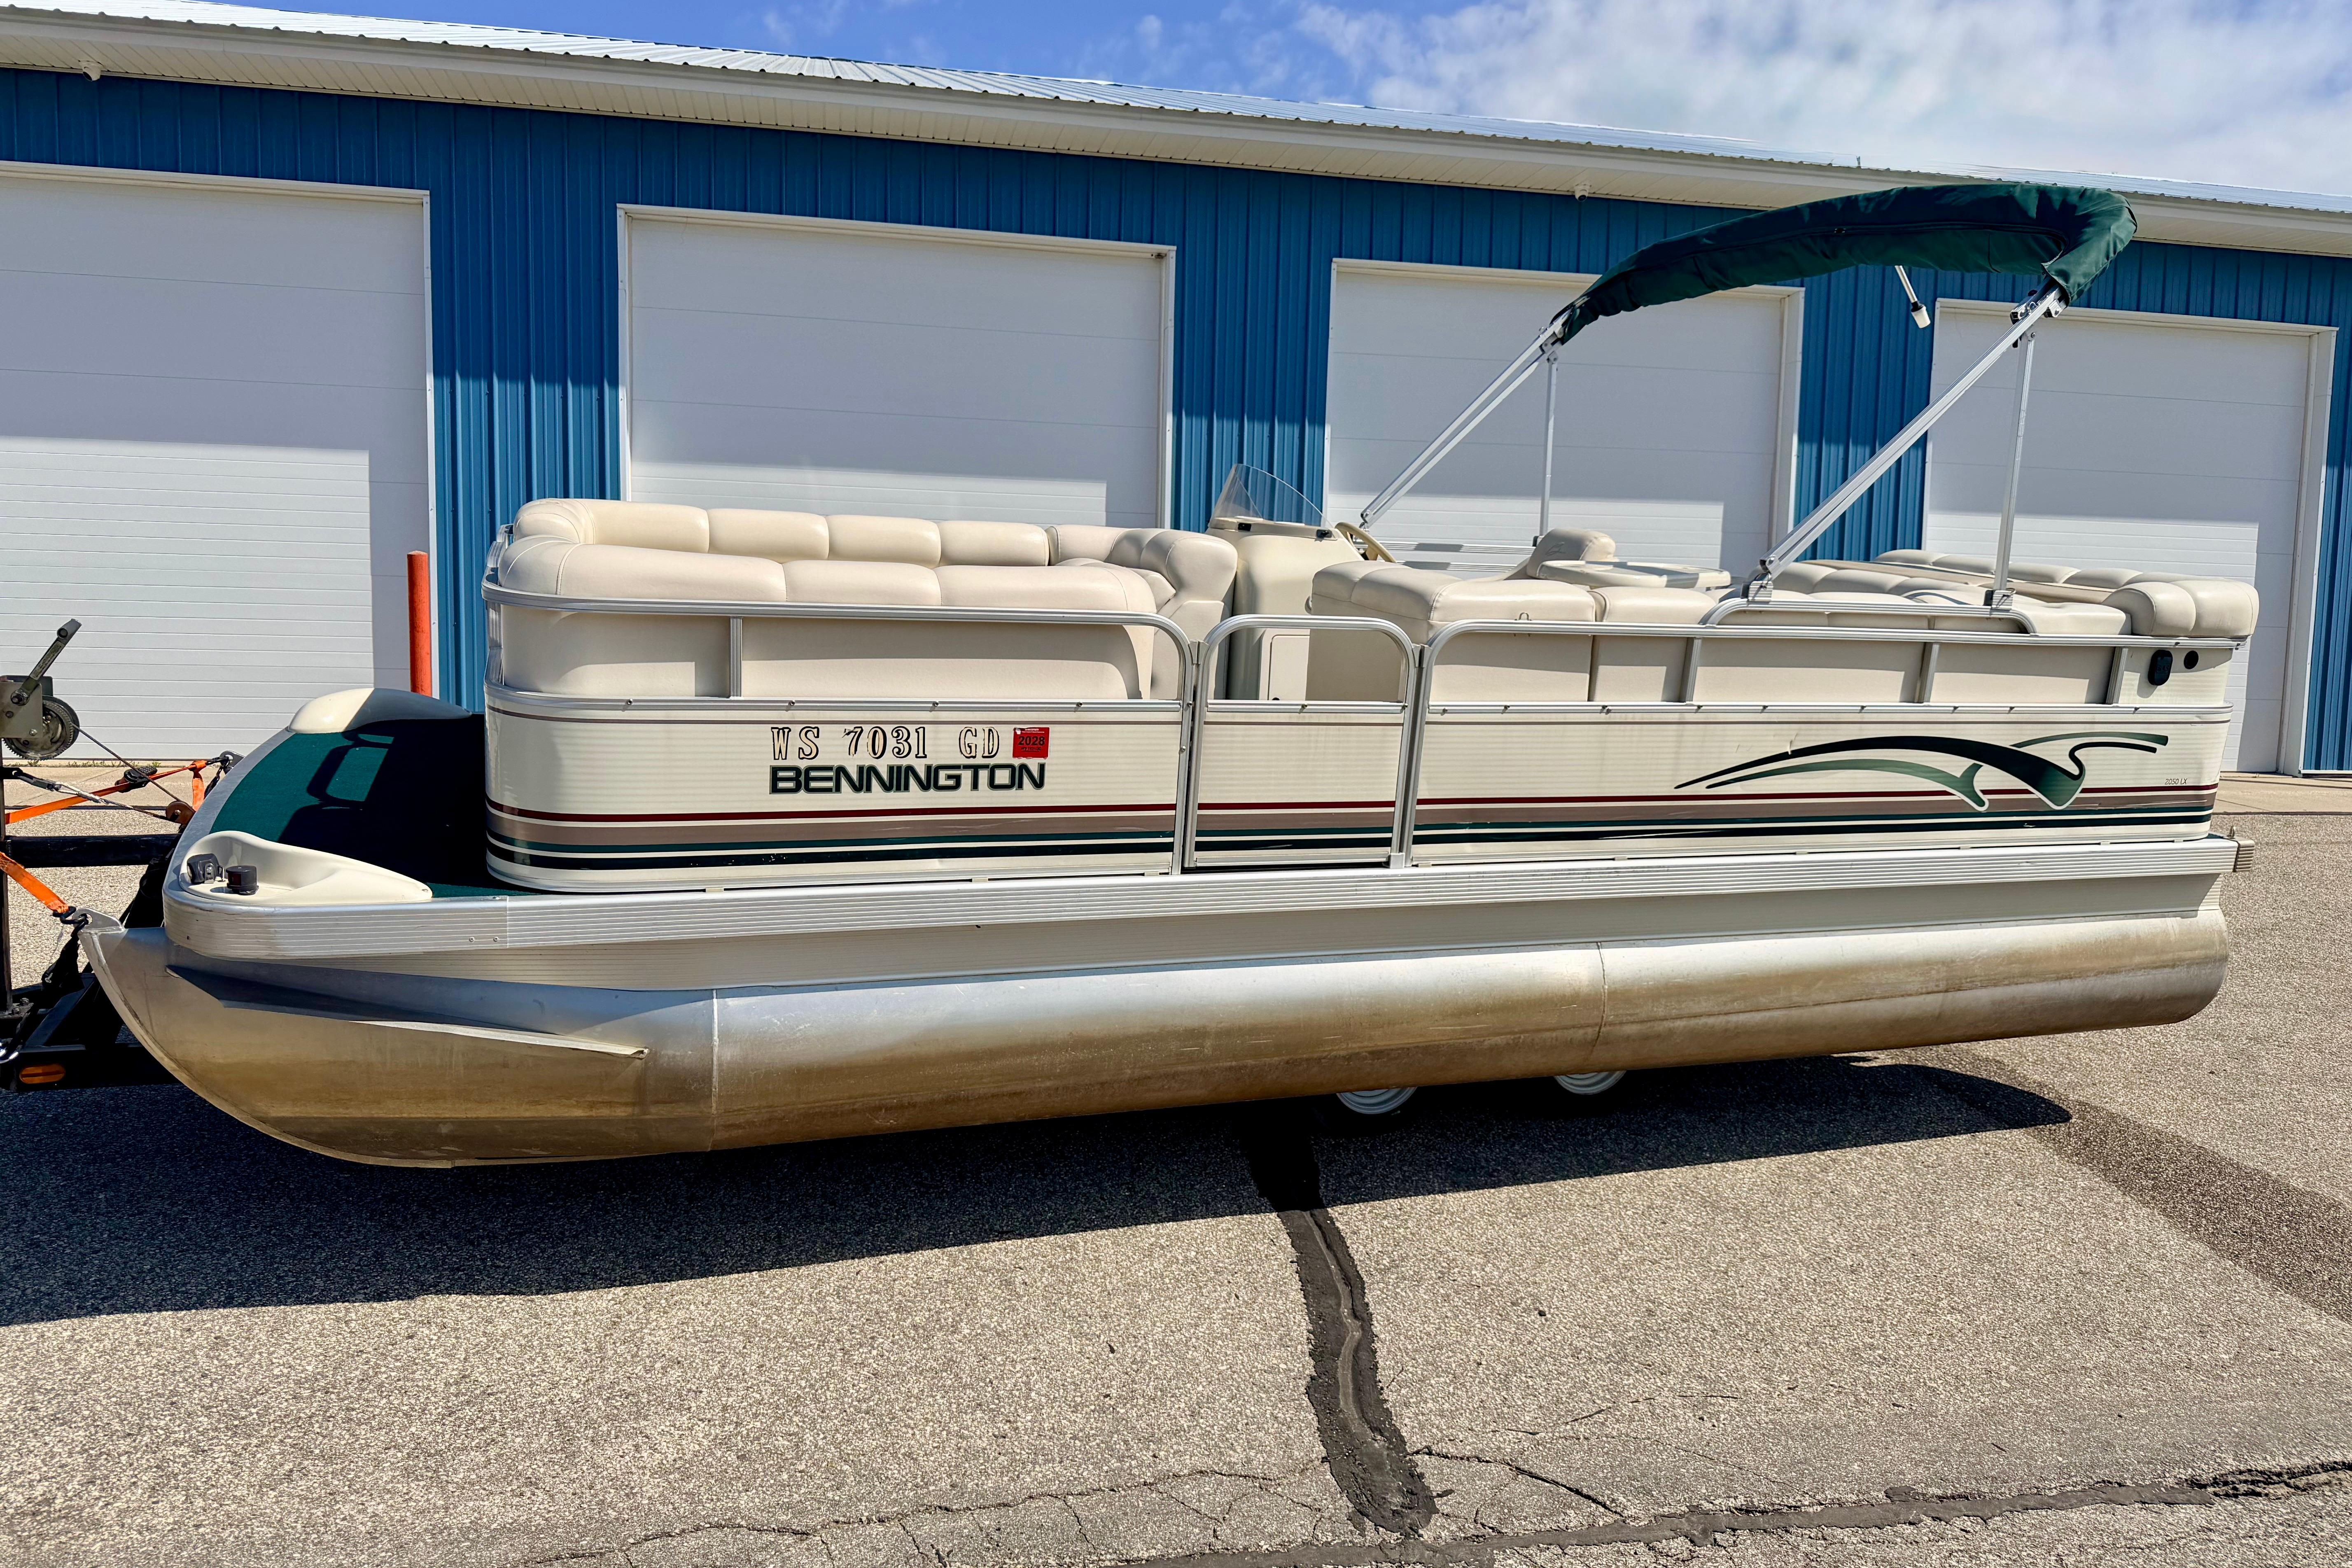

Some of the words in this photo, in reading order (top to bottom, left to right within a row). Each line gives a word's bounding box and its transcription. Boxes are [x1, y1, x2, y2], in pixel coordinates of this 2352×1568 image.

[771, 726, 820, 760] WS
[842, 726, 927, 759] 7031
[959, 726, 1000, 758] GD
[1018, 735, 1045, 746] 2028
[770, 762, 1046, 795] BENNINGTON
